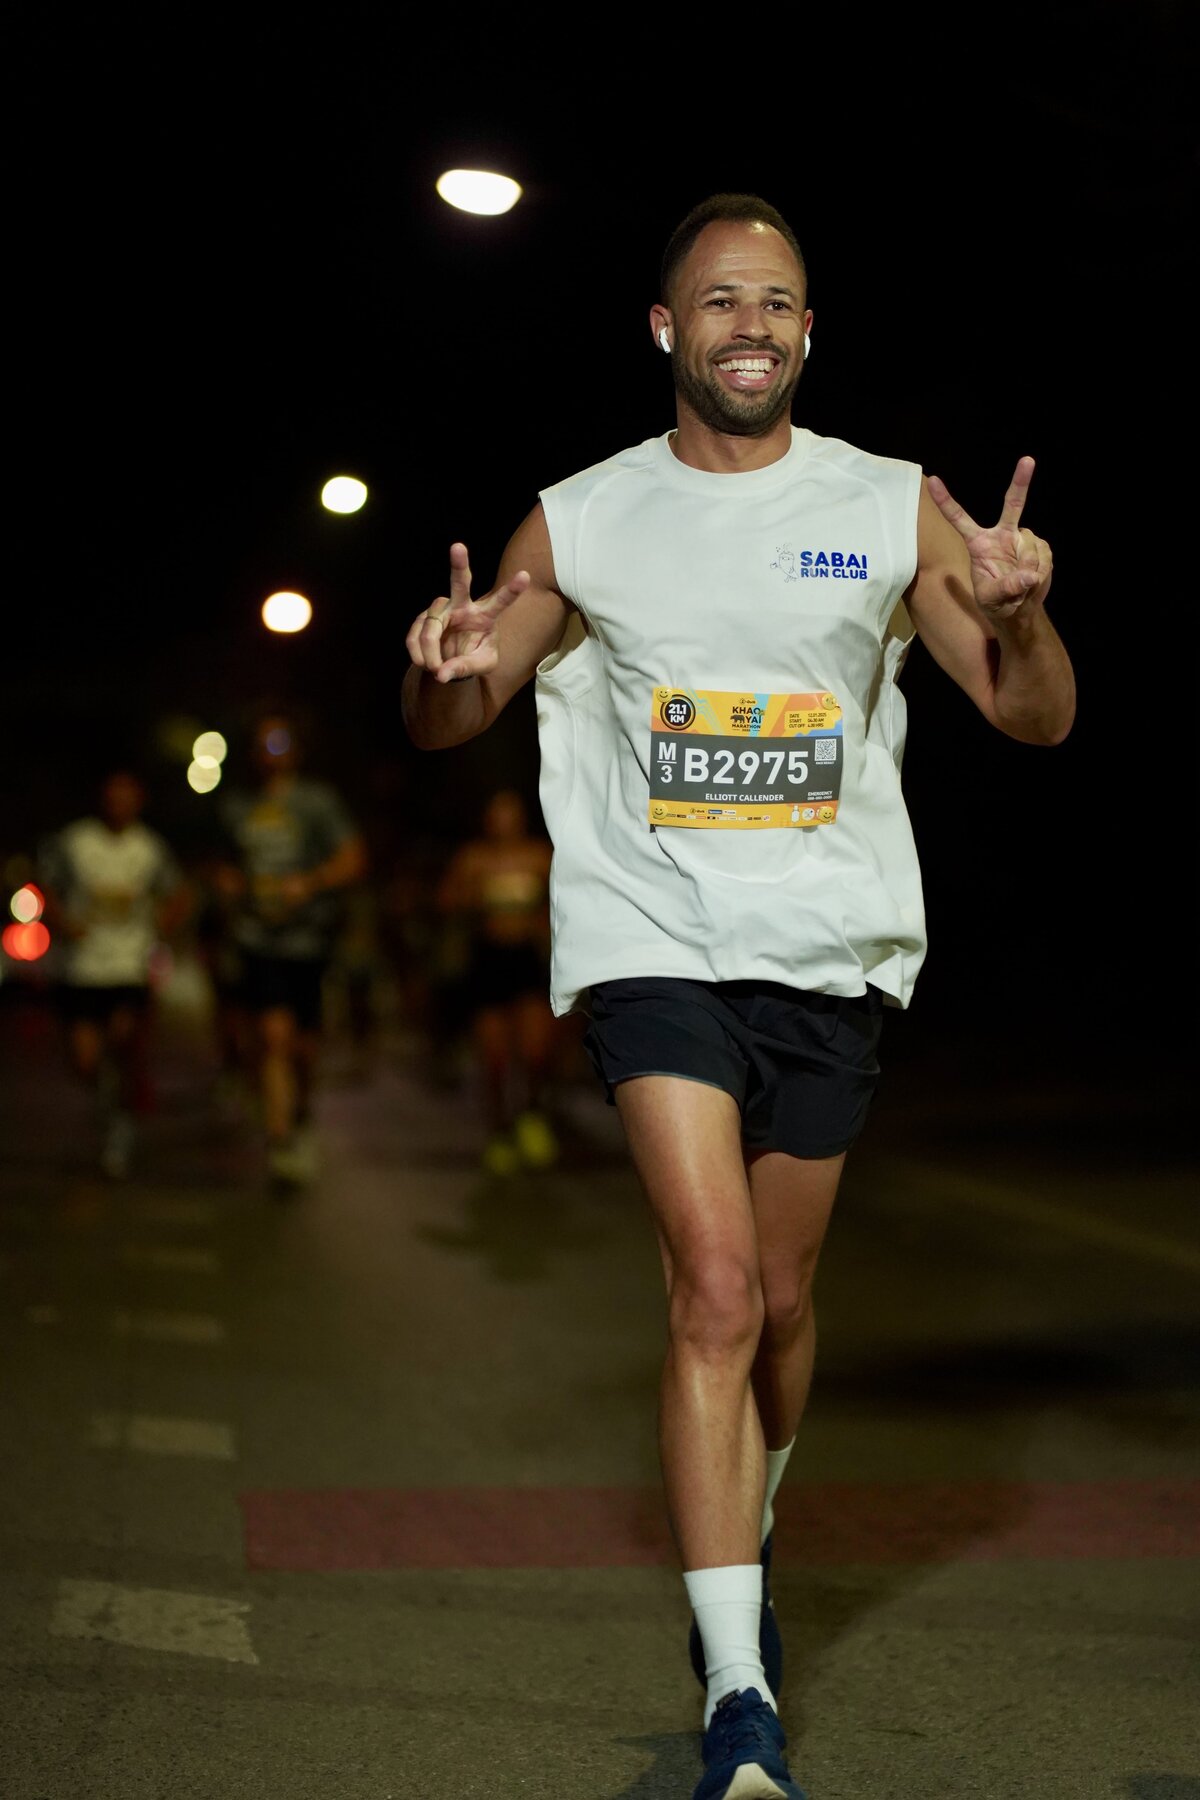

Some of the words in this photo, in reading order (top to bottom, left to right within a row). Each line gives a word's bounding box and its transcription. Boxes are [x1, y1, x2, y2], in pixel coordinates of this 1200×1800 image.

[800, 551, 867, 569] SABAI
[801, 568, 828, 578] RUN
[832, 568, 867, 580] CLUB
[668, 703, 687, 715] 21.1
[732, 706, 761, 715] KHAO
[670, 715, 685, 724] KM
[745, 715, 762, 724] YAI
[658, 742, 677, 761] M
[684, 747, 808, 785] B2975
[660, 765, 673, 783] 3
[705, 793, 737, 801] ELLIOTT
[739, 794, 784, 802] CALLENDER
